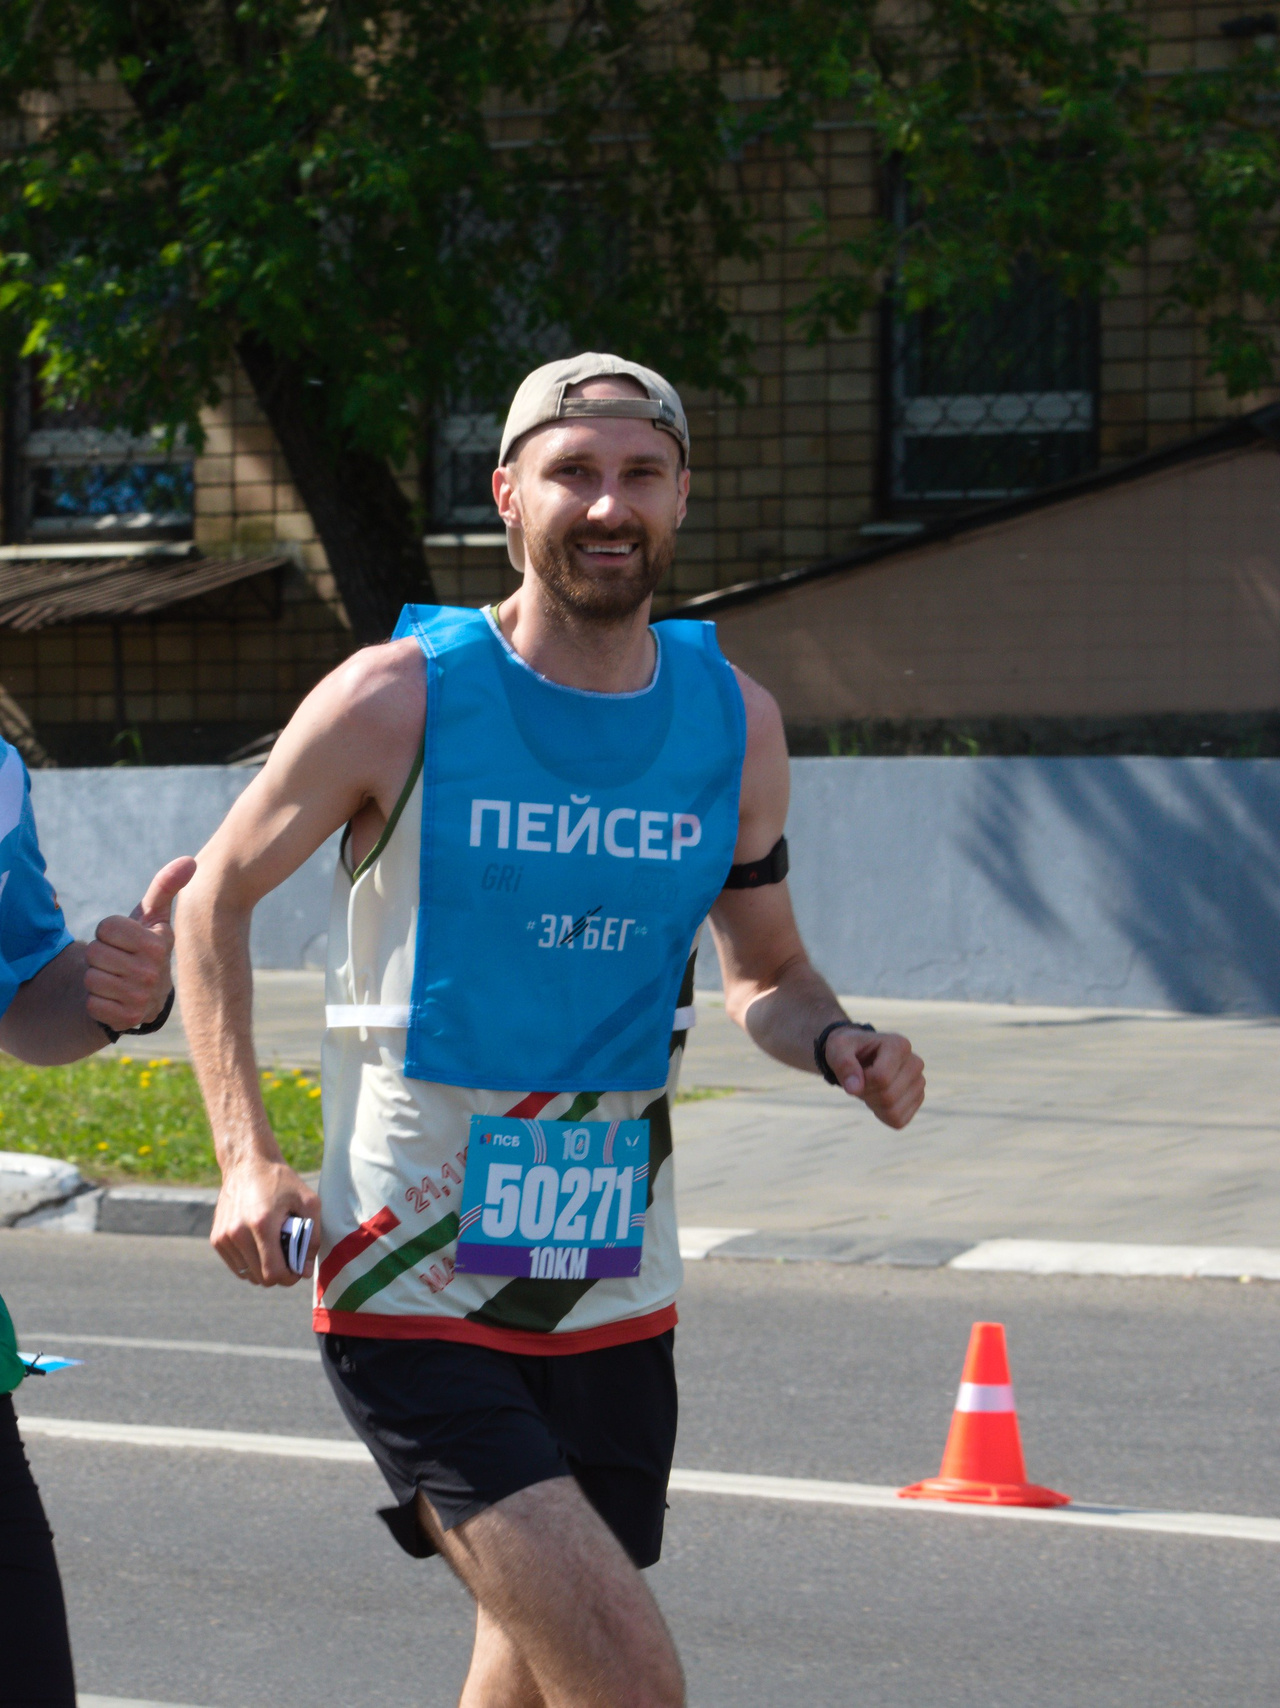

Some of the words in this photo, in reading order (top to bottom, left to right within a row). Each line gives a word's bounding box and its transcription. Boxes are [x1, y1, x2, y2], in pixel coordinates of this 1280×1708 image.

[469, 794, 702, 861] ПЕЙСЕР
[493, 1134, 520, 1148] ПСБ
[562, 1127, 591, 1161] 10
[481, 1162, 634, 1240] 50271
